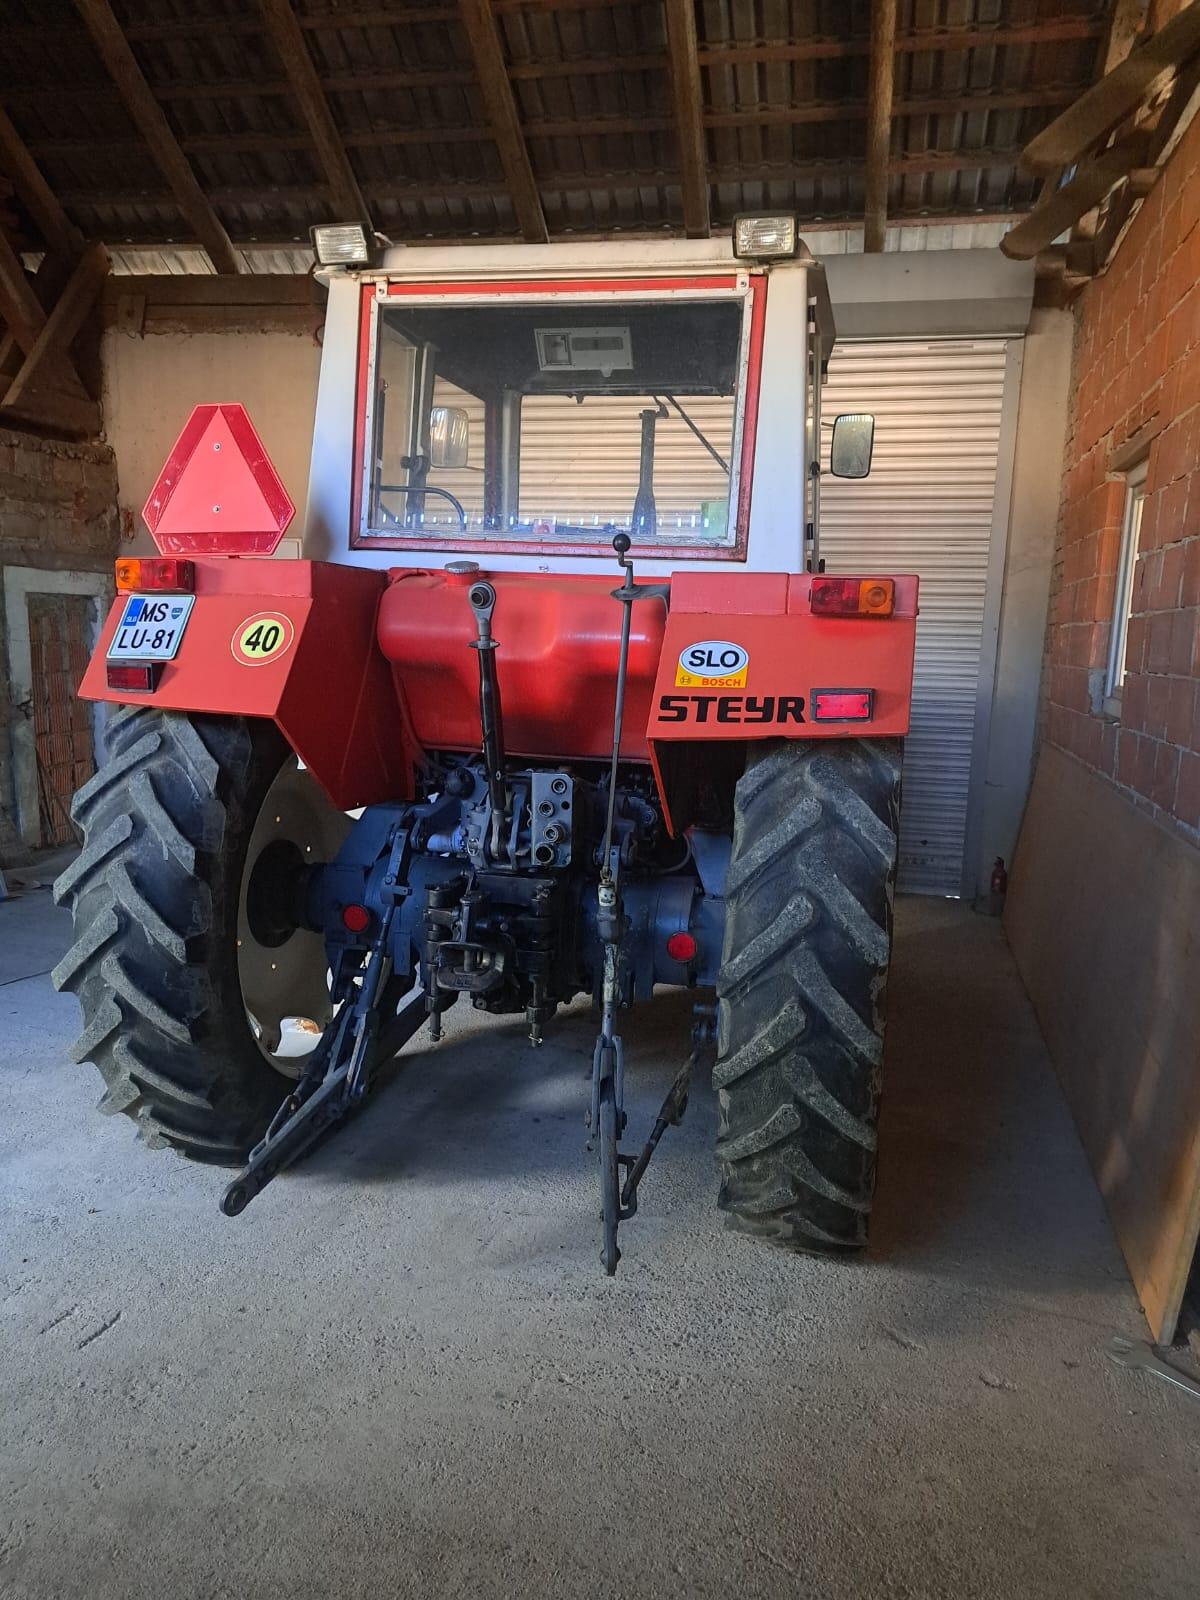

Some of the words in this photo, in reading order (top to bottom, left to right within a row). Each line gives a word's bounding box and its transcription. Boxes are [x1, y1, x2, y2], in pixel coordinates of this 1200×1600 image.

[139, 603, 168, 622] MS
[118, 629, 174, 649] LU-81
[245, 625, 279, 652] 40
[688, 649, 740, 668] SLO
[702, 678, 741, 686] BOSCH
[658, 696, 805, 723] STEYR
